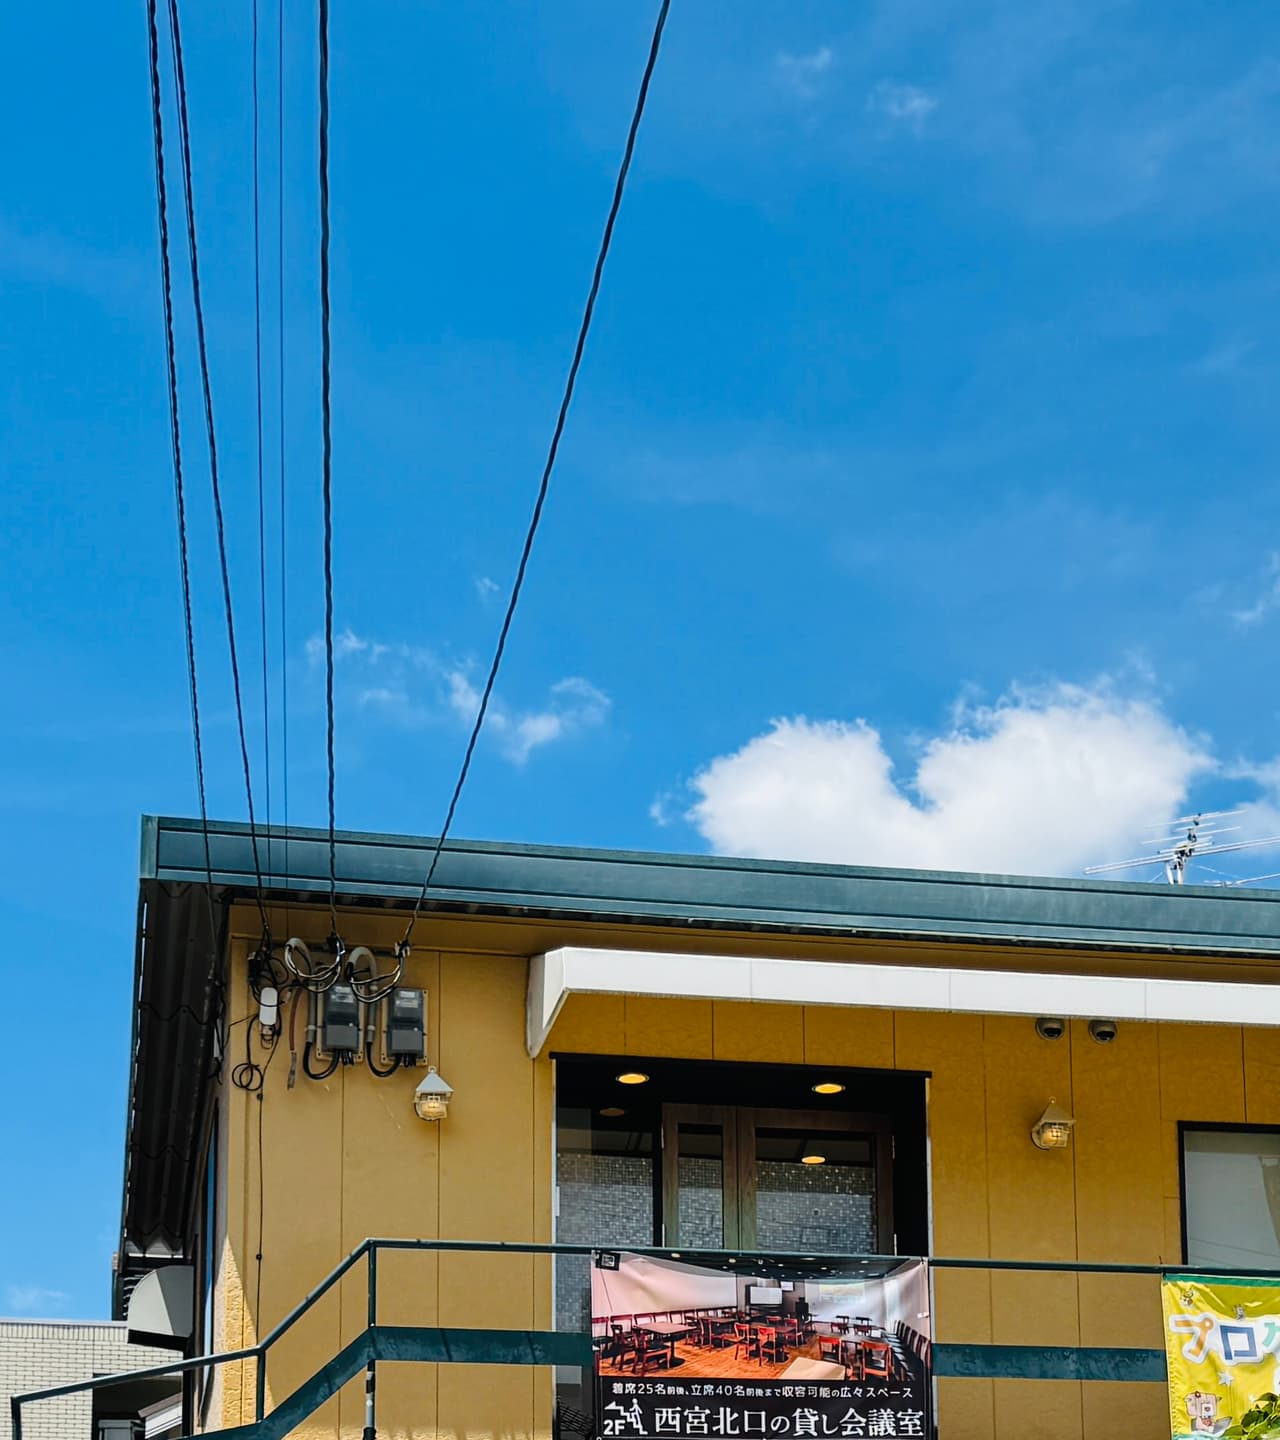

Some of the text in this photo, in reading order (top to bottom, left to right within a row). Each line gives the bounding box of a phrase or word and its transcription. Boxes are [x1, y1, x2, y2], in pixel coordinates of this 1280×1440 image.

[603, 1419, 625, 1436] 2F
[654, 1405, 924, 1438] 西宮北口の貸し会議室
